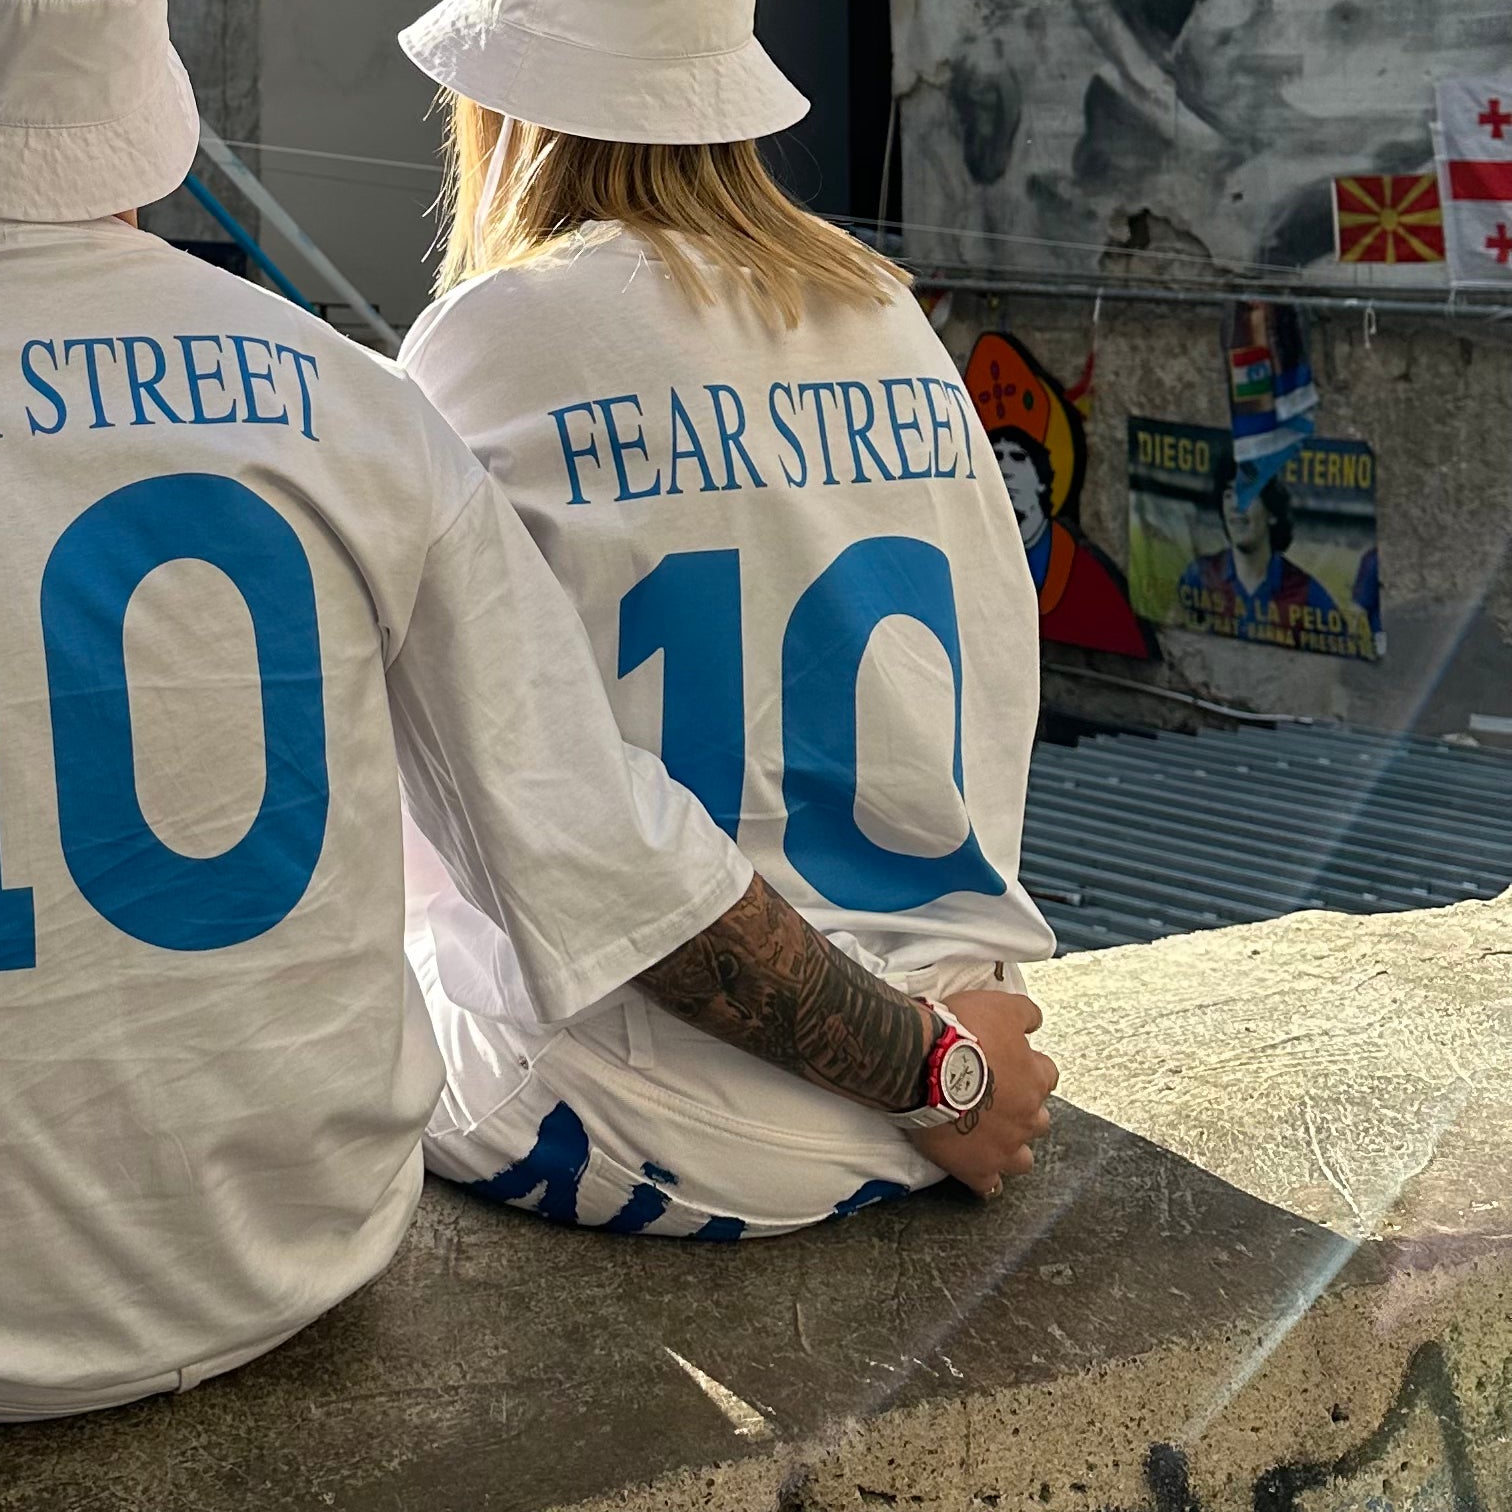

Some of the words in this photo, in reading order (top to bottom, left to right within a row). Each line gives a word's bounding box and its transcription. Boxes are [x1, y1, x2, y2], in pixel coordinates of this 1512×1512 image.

[21, 334, 320, 442] STREET
[547, 384, 768, 505] FEAR
[768, 377, 977, 489] STREET
[1137, 430, 1210, 474] DIEGO
[1283, 448, 1373, 489] ETERNO
[1254, 599, 1281, 623] LA
[1288, 604, 1373, 640] PELOTA
[617, 535, 1008, 913] 10
